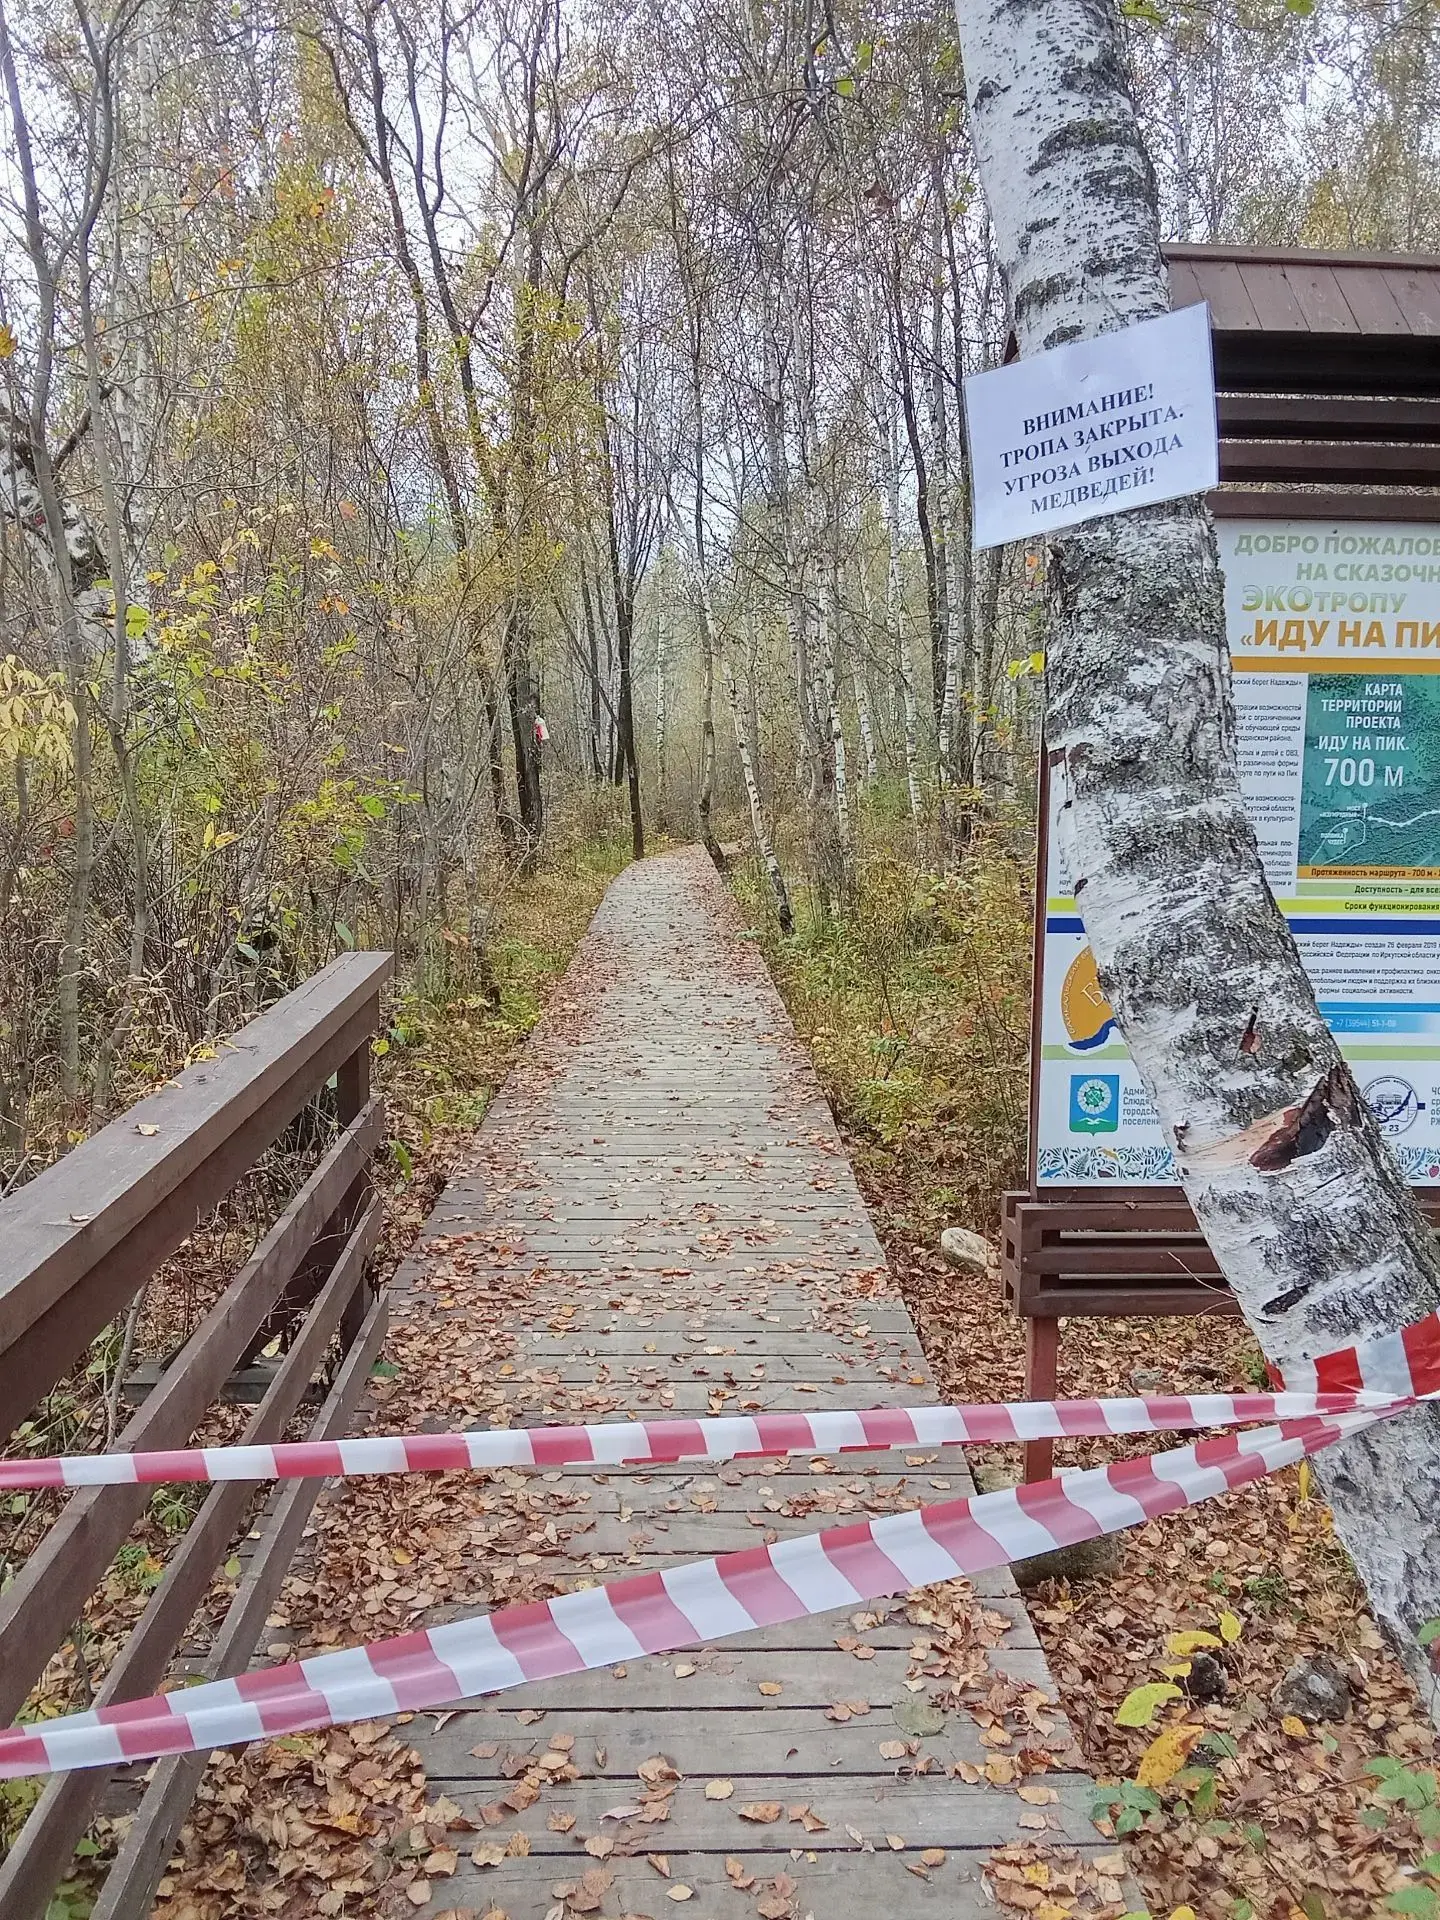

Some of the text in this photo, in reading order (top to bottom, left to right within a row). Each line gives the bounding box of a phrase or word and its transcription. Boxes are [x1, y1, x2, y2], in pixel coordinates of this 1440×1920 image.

[1023, 383, 1154, 436] ВНИМАНИЕ!
[1000, 405, 1184, 469] ТРОПА ЗАКРЫТА.
[1002, 433, 1183, 497] УГРОЗА ВЫХОДА
[1031, 467, 1155, 515] МЕДВЕДЕЙ!
[1234, 534, 1319, 556] ДОБРО
[1296, 563, 1328, 581] НА
[1240, 619, 1440, 651] «ИДУ НА ПИ
[1365, 683, 1403, 696] КАРТА
[1321, 699, 1402, 712] ТЕРРИТОРИИ
[1346, 716, 1401, 728] ПРОЕКТА
[1352, 736, 1371, 751] НА
[1324, 758, 1375, 787] 700
[1311, 868, 1367, 877] Протяженность
[1369, 870, 1406, 878] маршрута
[1412, 869, 1426, 877] 700
[1355, 886, 1403, 894] Доступность
[1345, 902, 1440, 911] Сроки функционирования
[1389, 1124, 1400, 1132] 23
